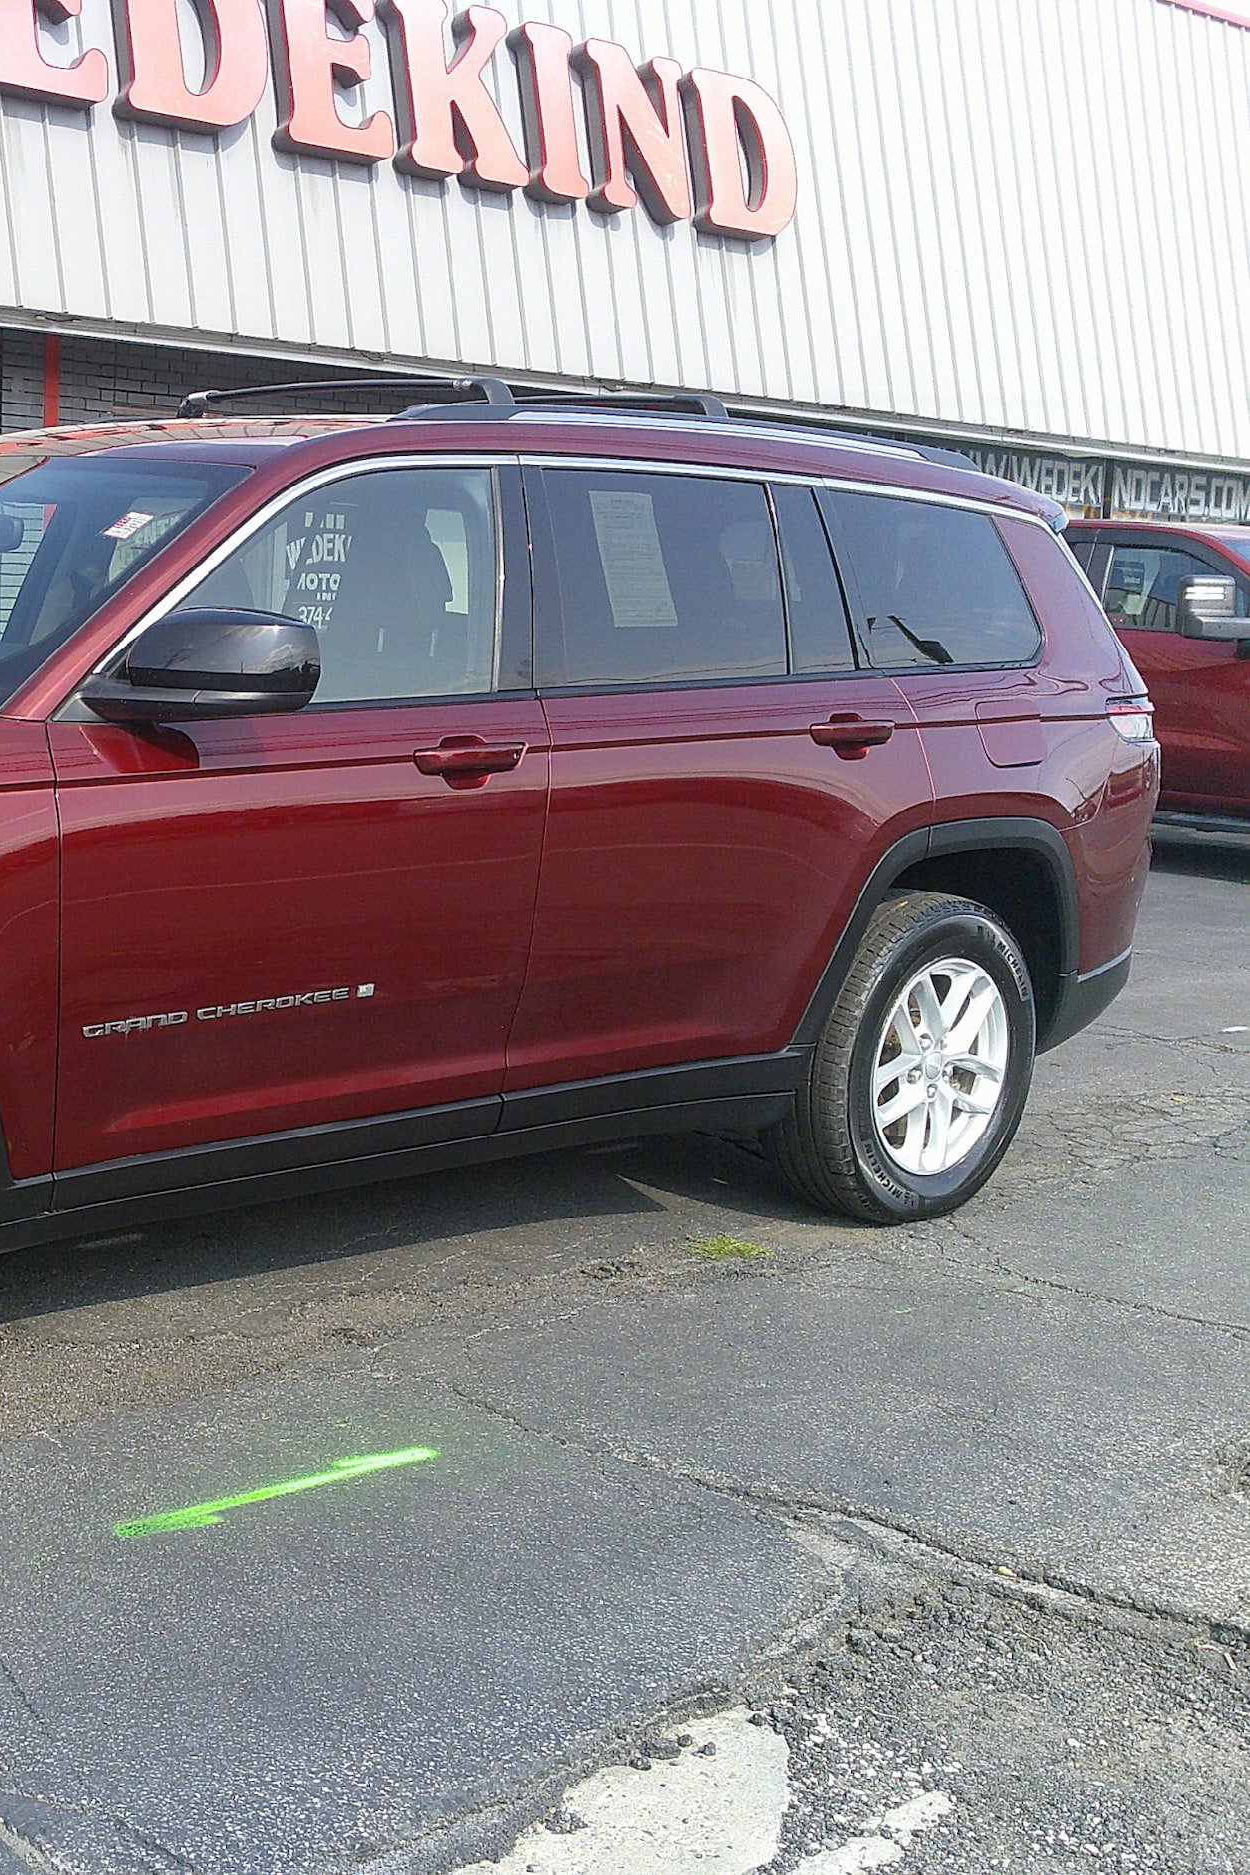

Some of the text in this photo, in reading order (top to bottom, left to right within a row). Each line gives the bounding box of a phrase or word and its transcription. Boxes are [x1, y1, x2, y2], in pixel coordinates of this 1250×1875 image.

[996, 941, 1029, 997] MICHELIN
[82, 1011, 188, 1038] GRAND
[196, 987, 349, 1021] CHEROKEE
[864, 1143, 903, 1199] MICHELIN
